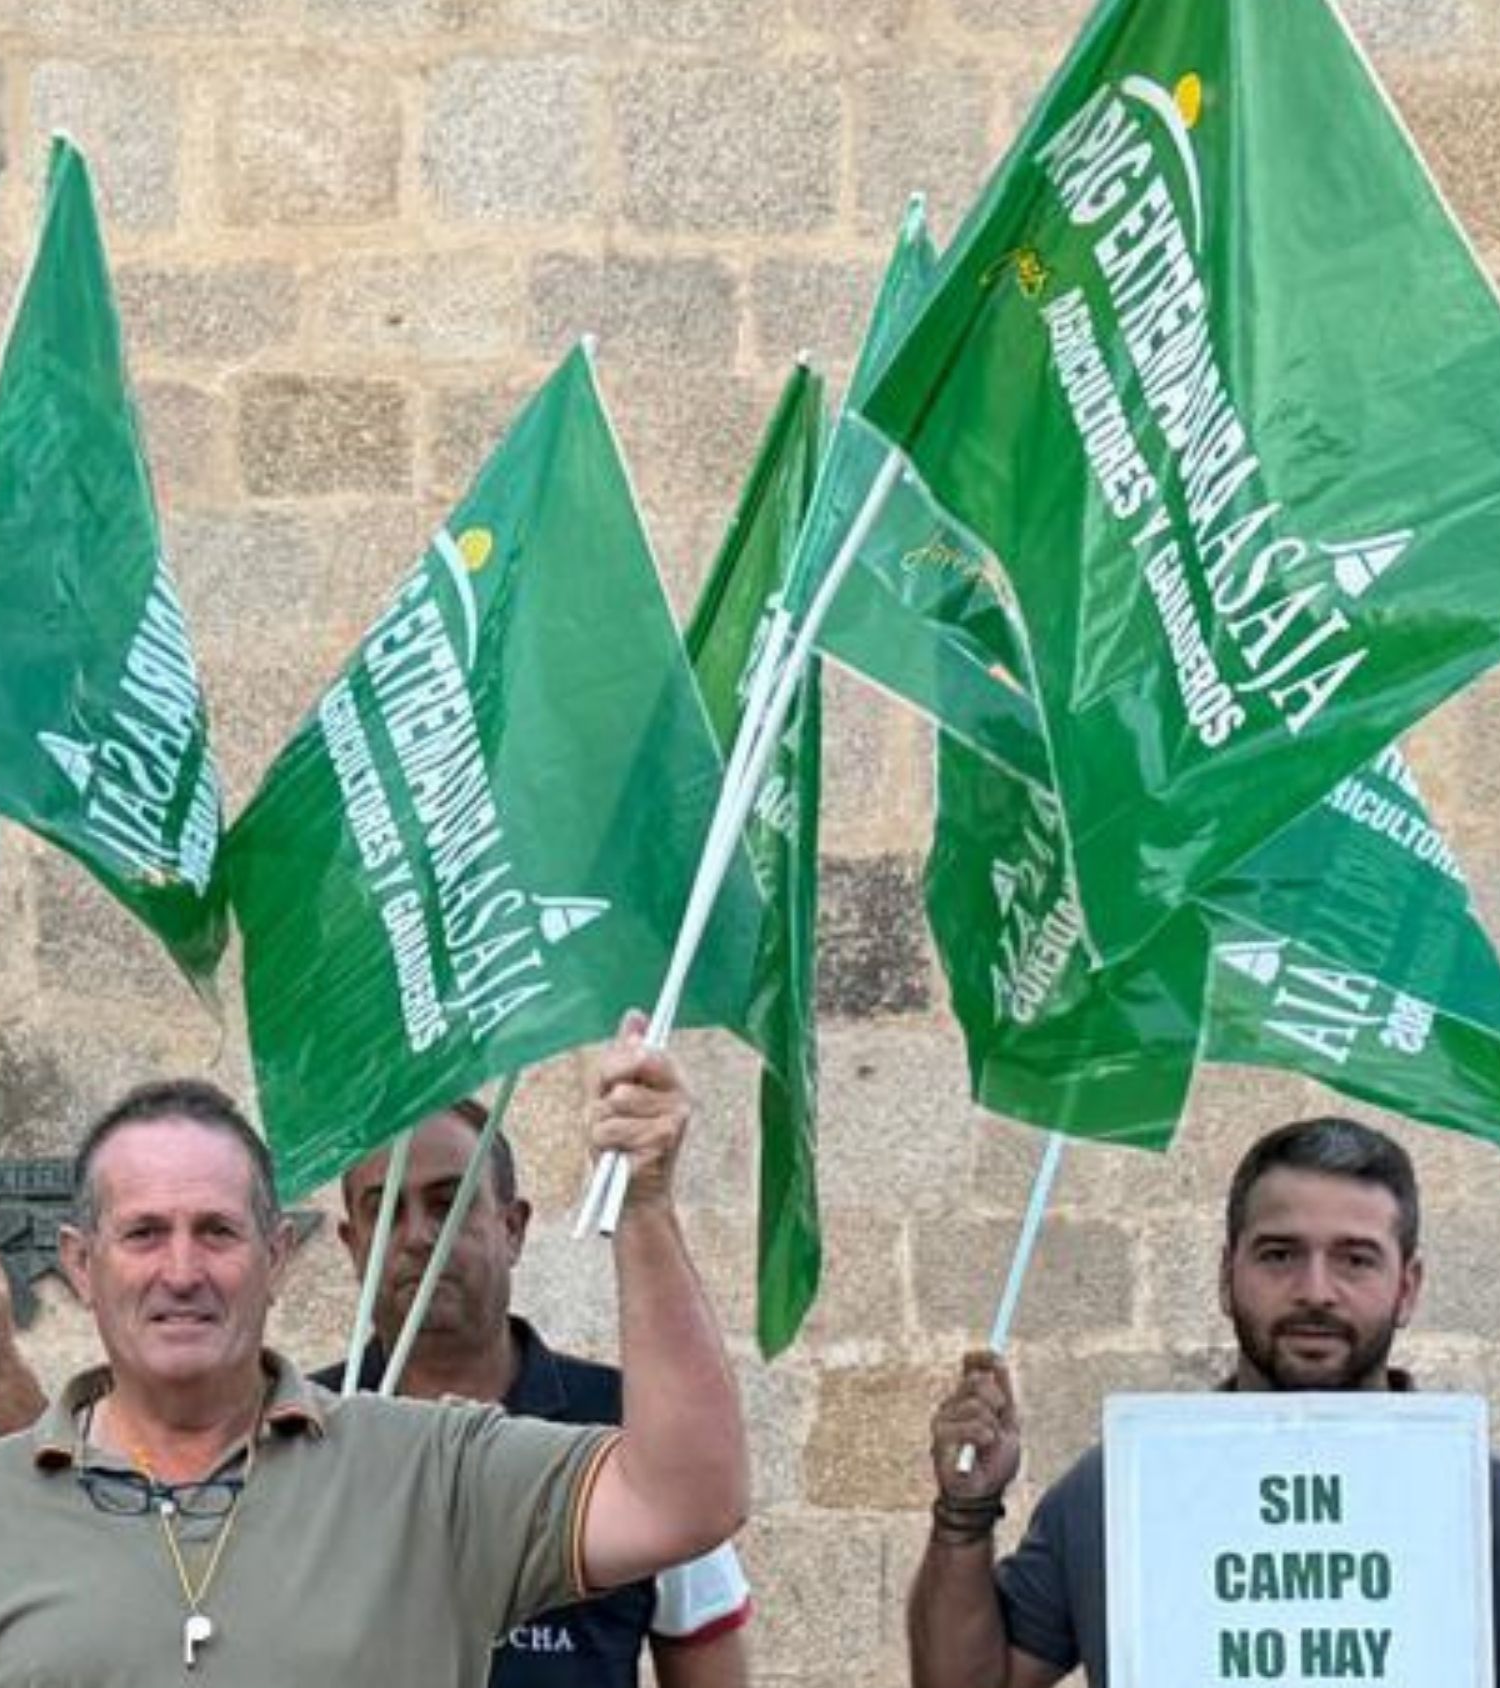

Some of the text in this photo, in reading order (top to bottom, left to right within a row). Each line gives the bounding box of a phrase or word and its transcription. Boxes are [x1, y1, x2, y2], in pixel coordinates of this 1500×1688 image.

[1034, 83, 1368, 735] APAG EXTREMADURA ASAJA
[1040, 288, 1245, 746] AGRICULTORES Y GANADEROS
[365, 599, 503, 907] EXTREMADURA
[443, 863, 552, 1043] ASAJA
[371, 862, 414, 893] Y
[382, 890, 449, 1053] GANADEROS
[1259, 1475, 1342, 1524] SIN
[1215, 1551, 1390, 1602] CAMPO
[494, 1624, 576, 1652] CHA
[1218, 1628, 1393, 1679] NO HAY
